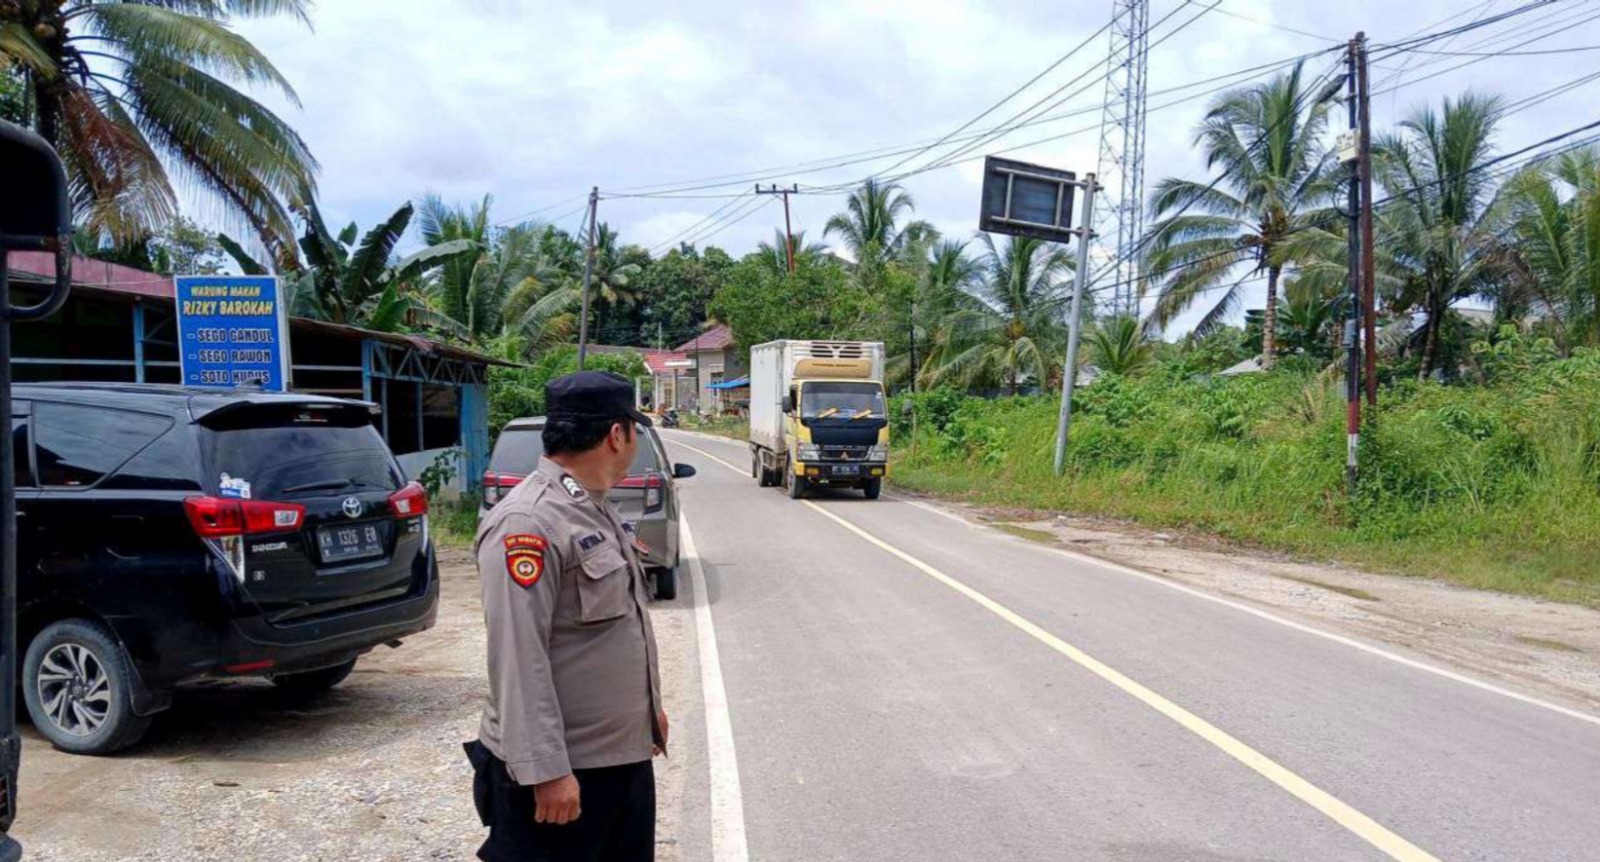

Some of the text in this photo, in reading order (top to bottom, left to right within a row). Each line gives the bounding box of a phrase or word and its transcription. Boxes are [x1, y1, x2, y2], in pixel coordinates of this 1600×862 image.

[191, 286, 261, 297] WARUNG MAKAN
[183, 301, 273, 315] RIZKY BAROKAH
[198, 328, 226, 343] SEGO
[229, 328, 274, 343] GANDUL
[199, 349, 229, 363] SEGO
[231, 349, 272, 363] RAWON
[201, 369, 229, 384] SOTO
[320, 531, 333, 547] KH
[338, 529, 359, 545] 1326
